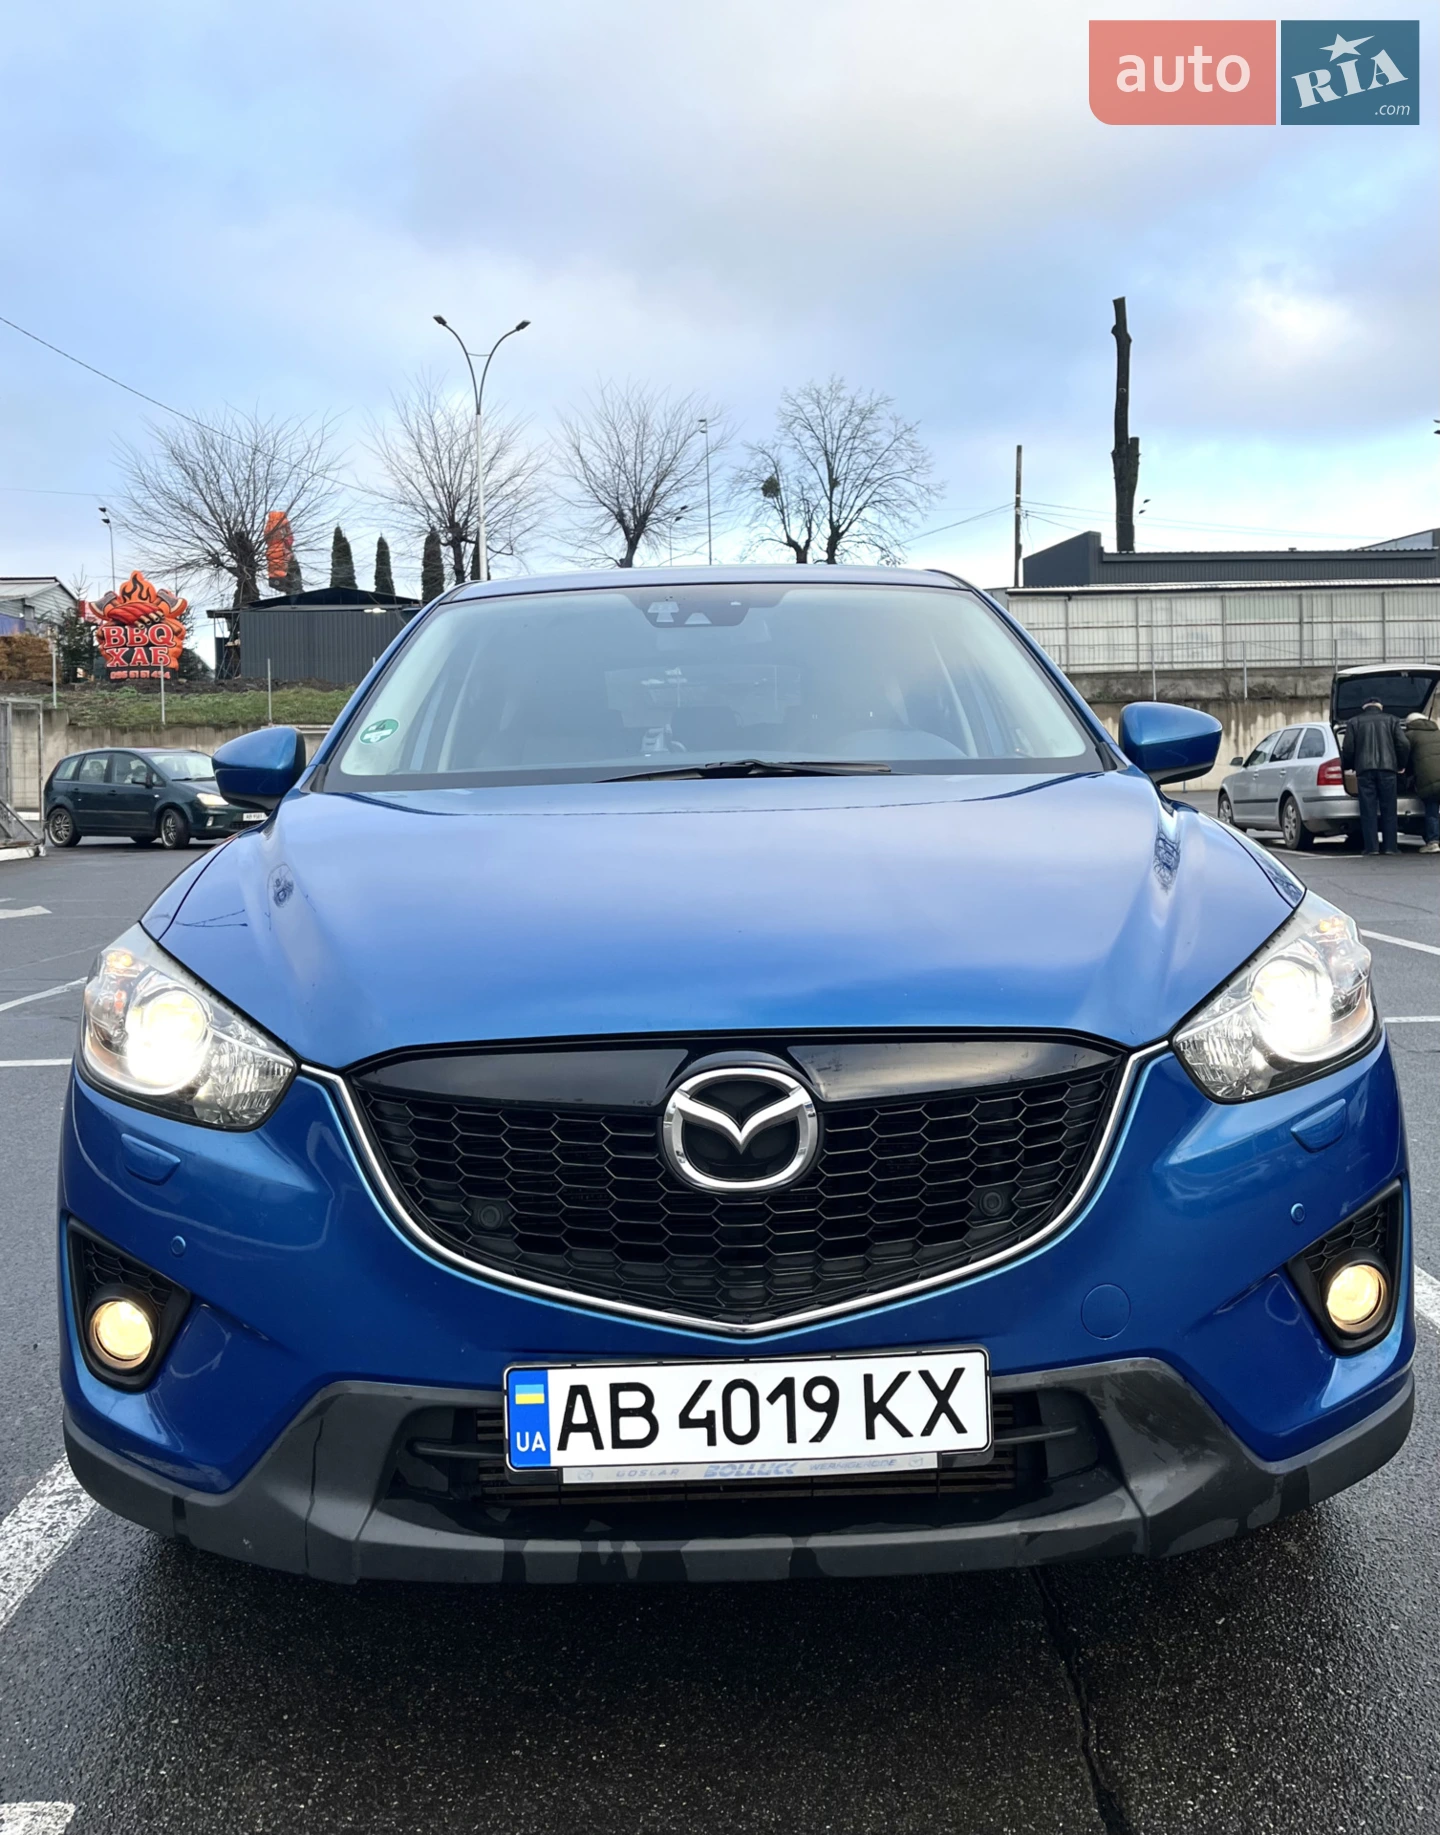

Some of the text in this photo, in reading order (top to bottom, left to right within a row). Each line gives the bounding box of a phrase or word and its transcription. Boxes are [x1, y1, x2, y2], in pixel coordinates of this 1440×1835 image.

[102, 623, 176, 648] BBQ
[106, 647, 171, 667] ХАБ
[557, 1367, 968, 1451] AB 4019 KX
[516, 1431, 547, 1453] UA
